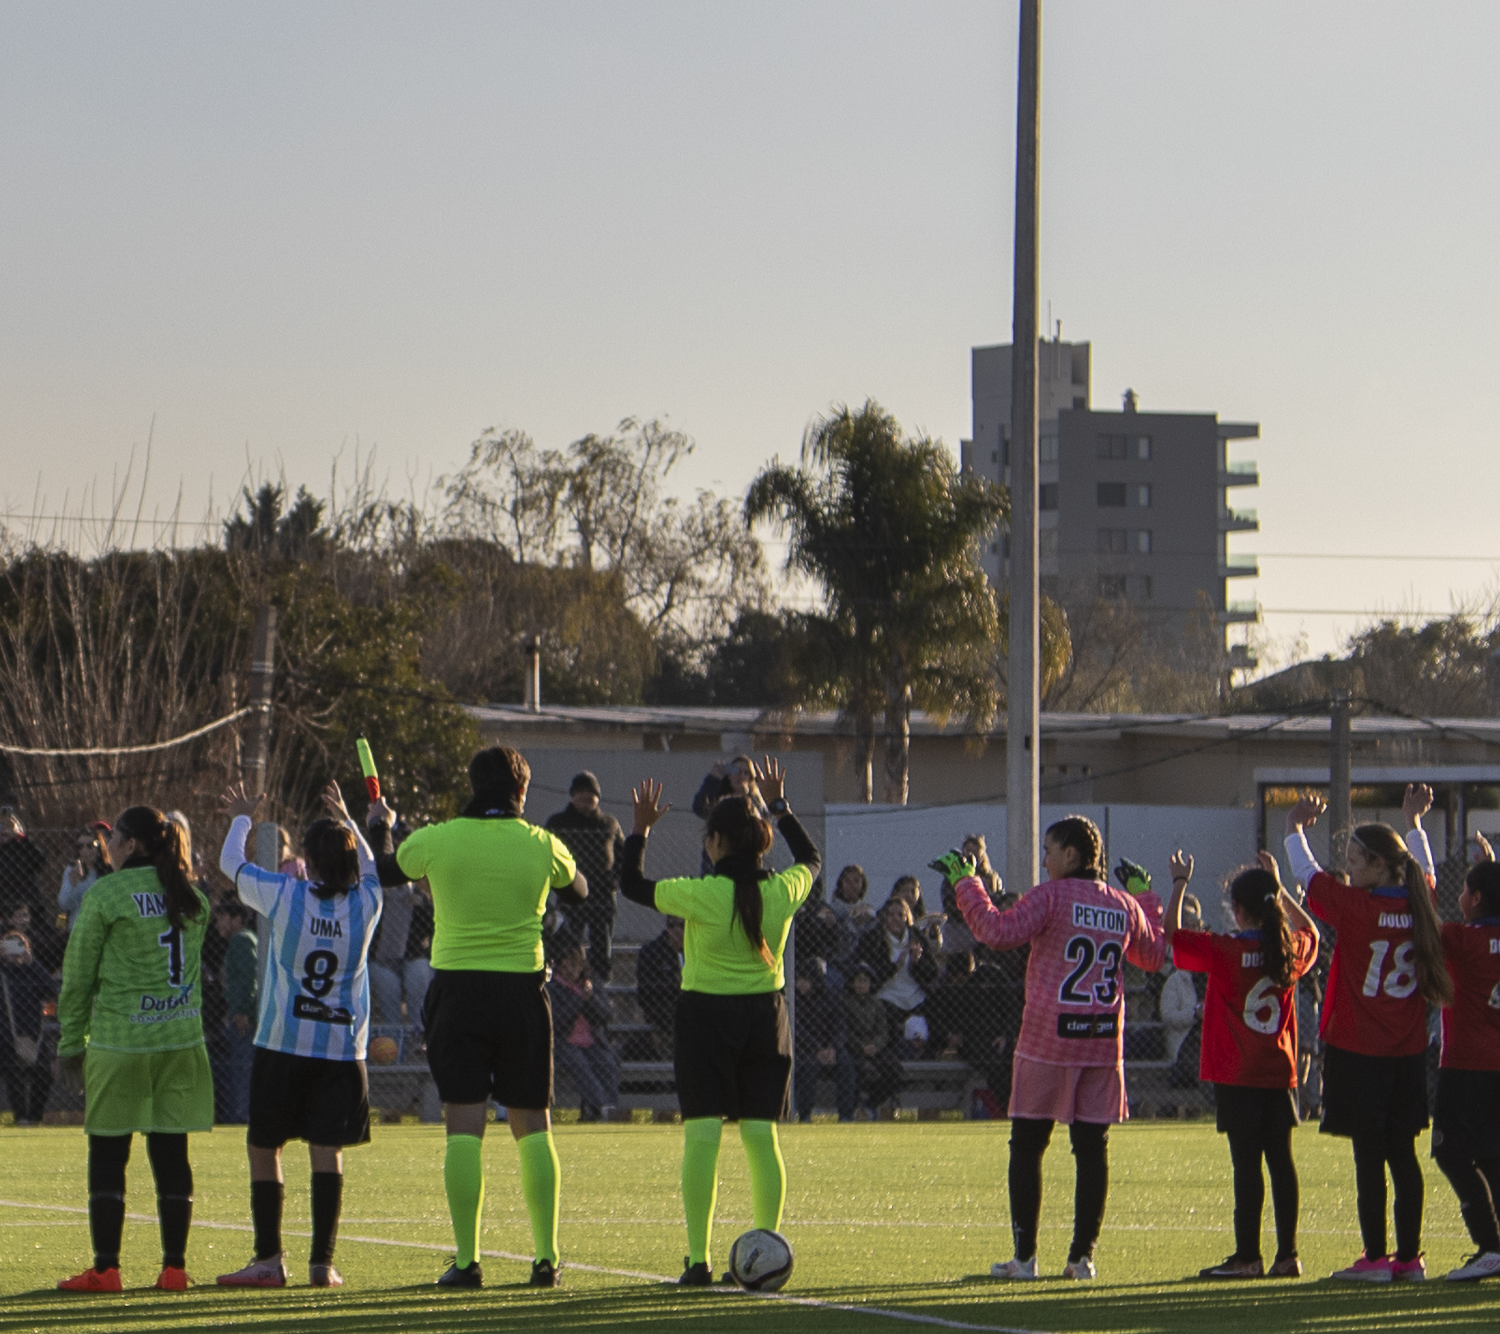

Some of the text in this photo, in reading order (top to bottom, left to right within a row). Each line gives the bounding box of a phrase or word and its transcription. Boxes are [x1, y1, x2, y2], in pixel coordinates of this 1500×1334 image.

[310, 917, 342, 938] UMA
[1074, 905, 1125, 932] PEYTON
[159, 926, 182, 985] 1
[302, 950, 338, 997] 8
[1060, 936, 1122, 1005] 23
[1363, 939, 1417, 999] 18
[1243, 976, 1280, 1035] 6
